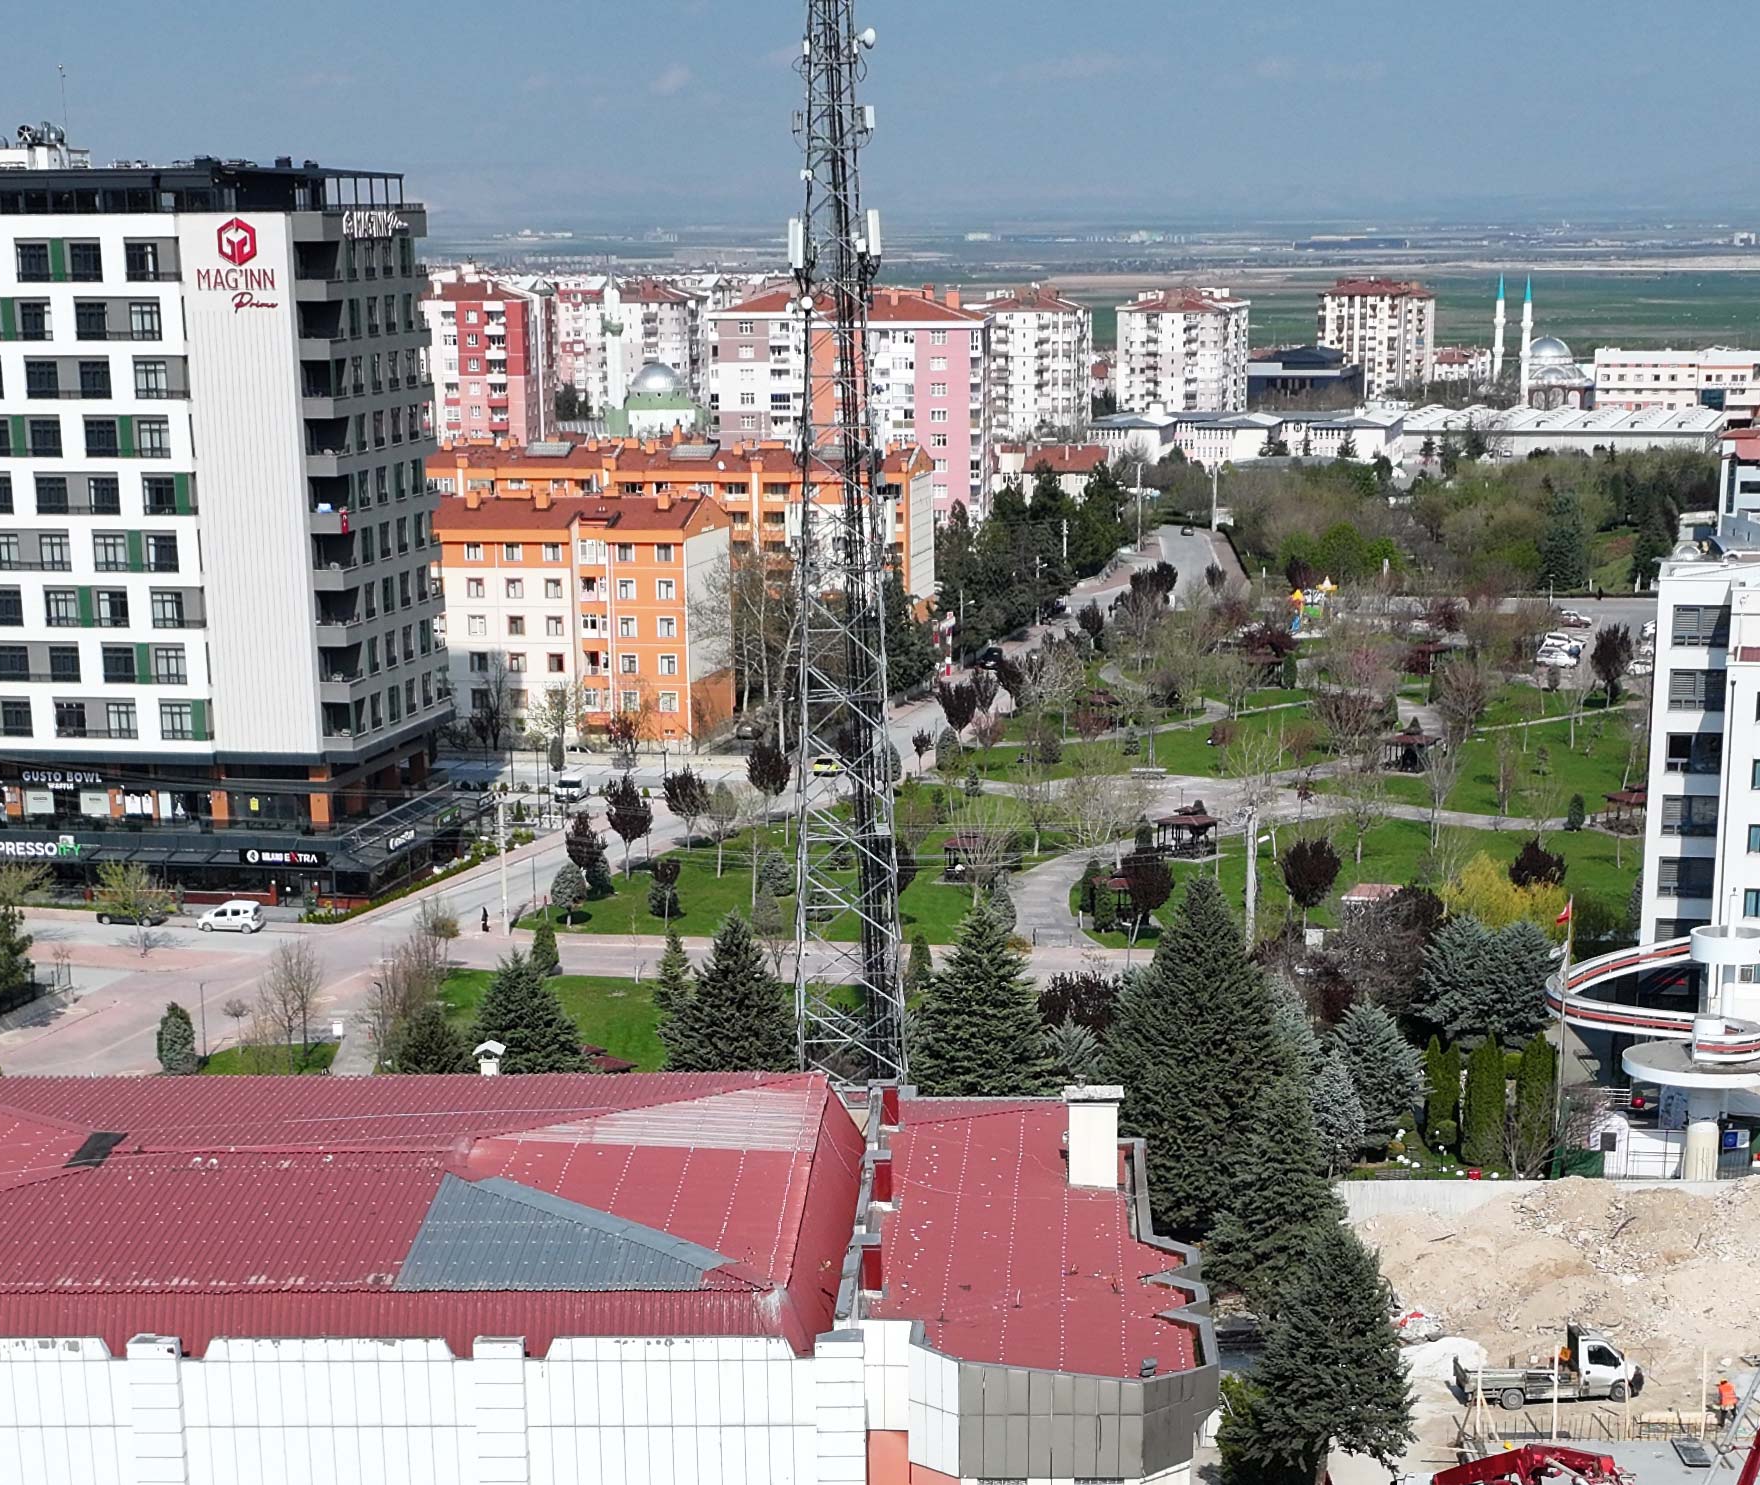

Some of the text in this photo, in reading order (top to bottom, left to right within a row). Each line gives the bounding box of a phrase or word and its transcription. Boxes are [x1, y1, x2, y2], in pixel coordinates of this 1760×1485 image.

[197, 268, 277, 291] MAG'INN
[231, 291, 278, 314] Prime
[22, 770, 102, 784] GUSTO BOWL
